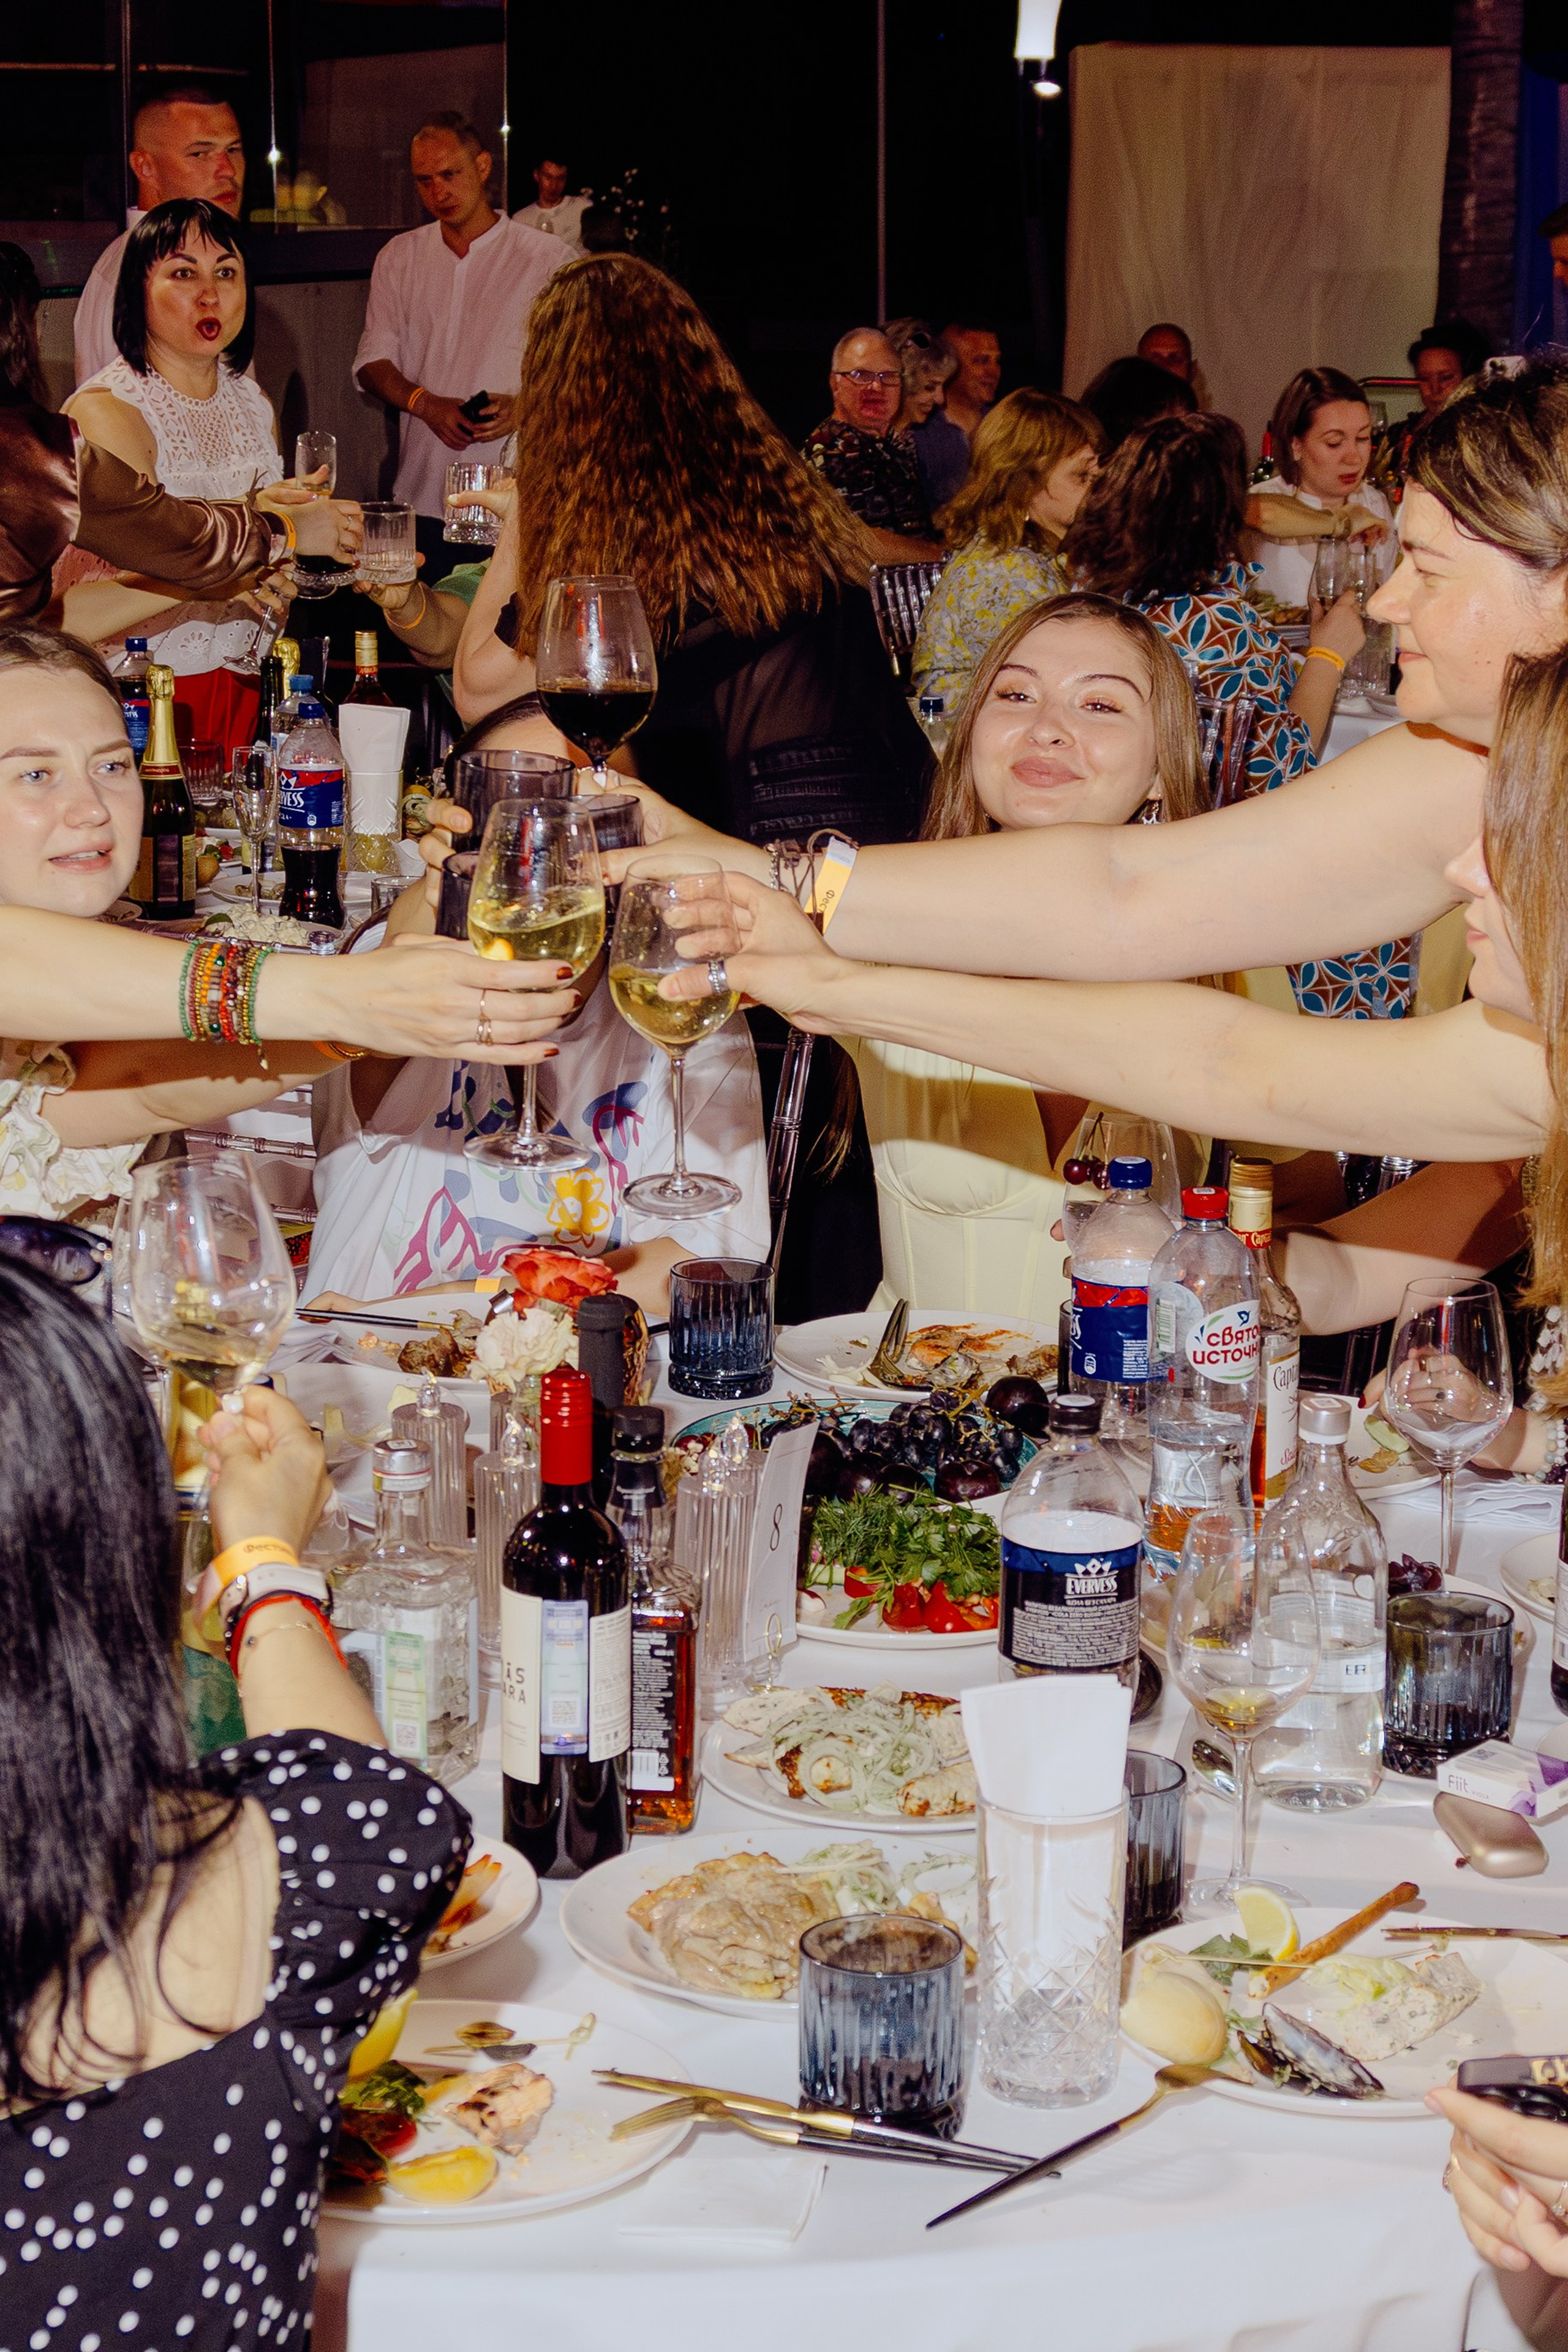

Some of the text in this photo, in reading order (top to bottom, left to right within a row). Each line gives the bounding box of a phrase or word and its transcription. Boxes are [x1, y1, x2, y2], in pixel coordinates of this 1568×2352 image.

[770, 1503, 783, 1551] 8
[1066, 1577, 1117, 1594] EVERVESS
[1448, 1774, 1469, 1794] Fiit
